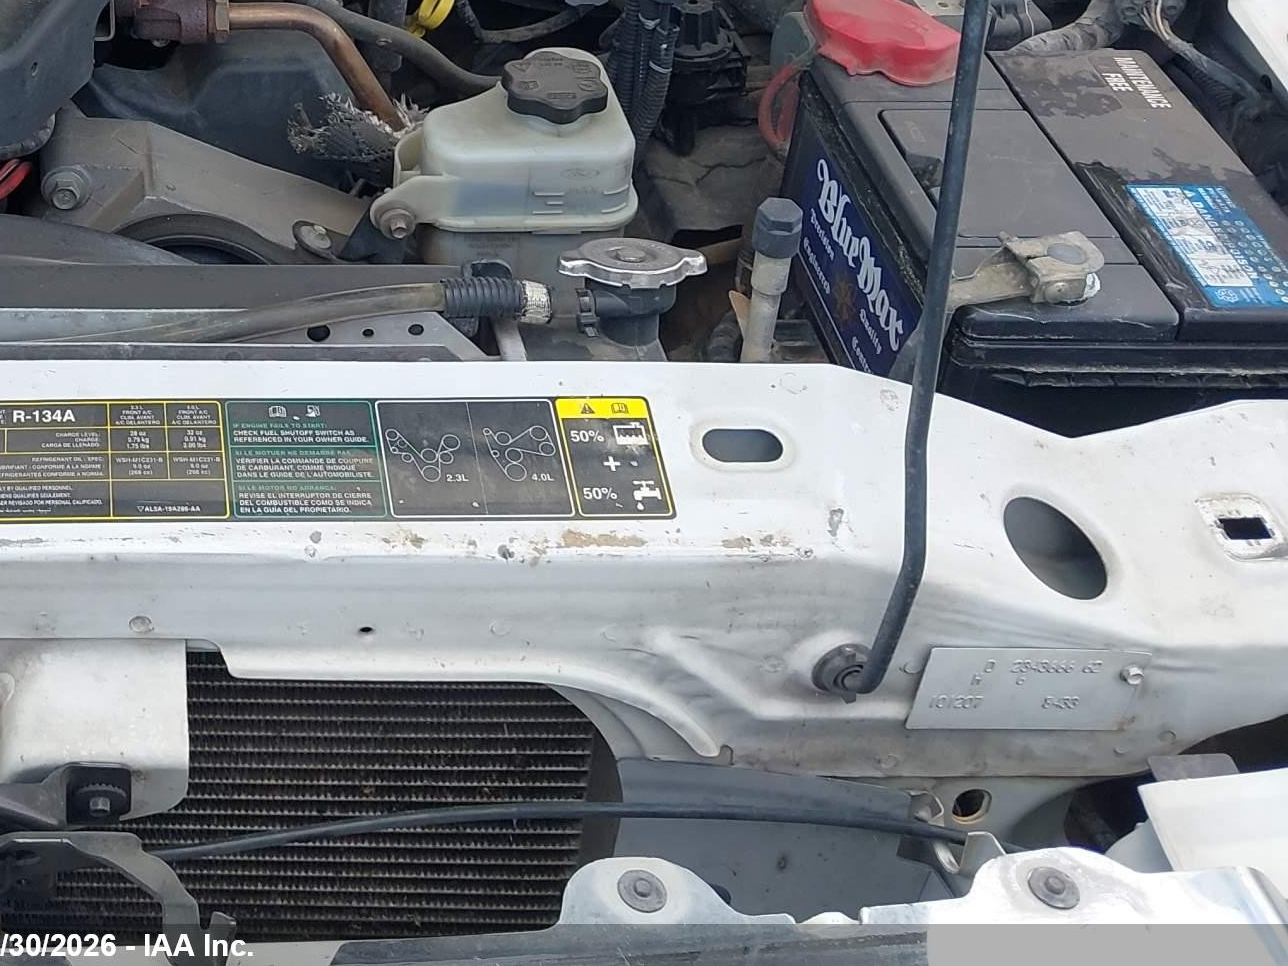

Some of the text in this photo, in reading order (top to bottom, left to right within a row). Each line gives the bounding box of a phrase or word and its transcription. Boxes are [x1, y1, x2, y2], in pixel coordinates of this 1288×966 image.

[1102, 73, 1134, 92] FREE
[1113, 57, 1173, 109] MAINTENANCE
[12, 409, 76, 423] R-134A
[570, 430, 604, 443] 50%
[446, 474, 469, 482] 2.3L
[531, 473, 554, 482] 4.0L
[583, 488, 617, 500] 50%
